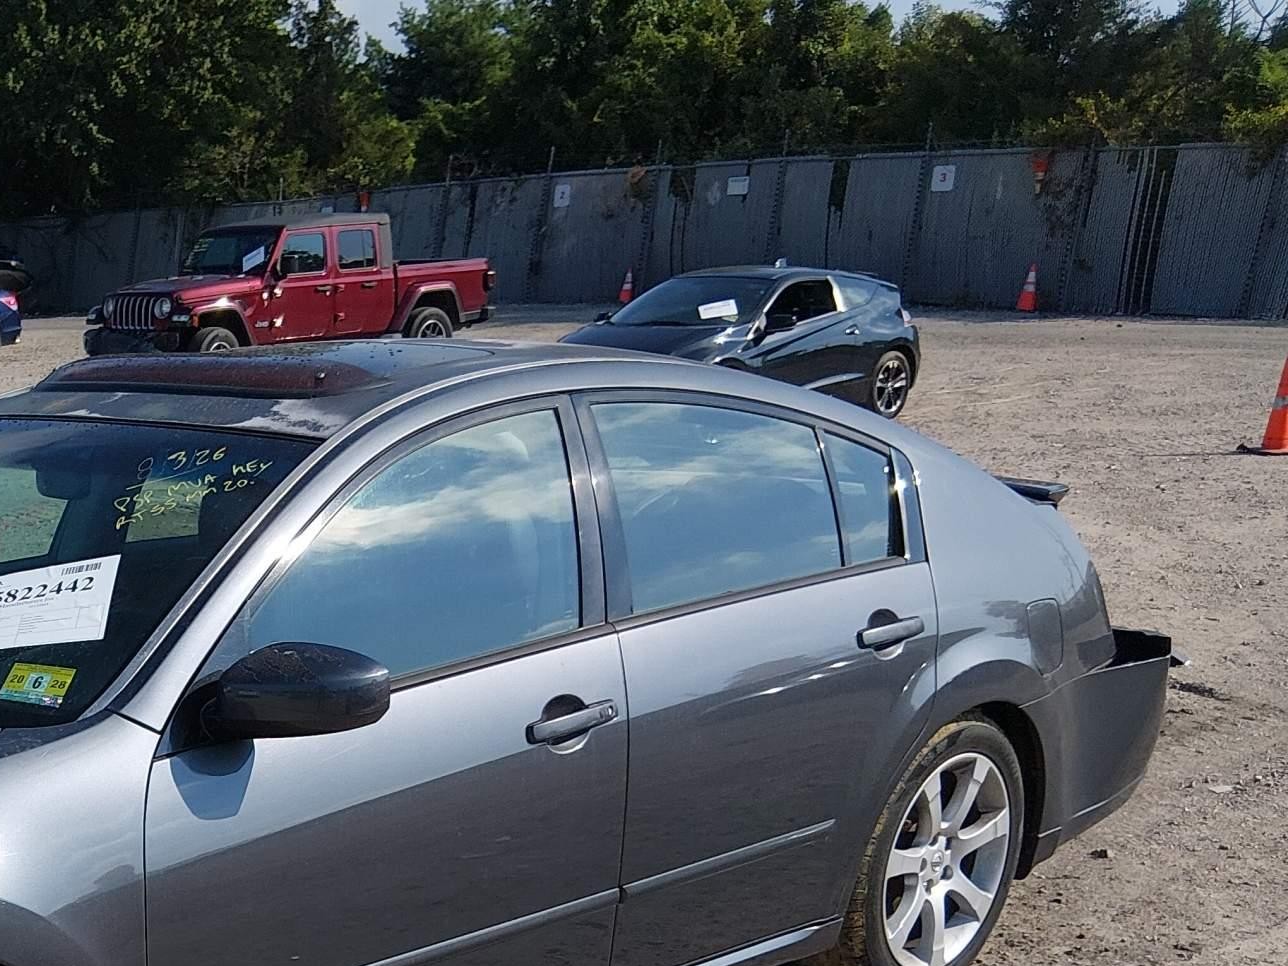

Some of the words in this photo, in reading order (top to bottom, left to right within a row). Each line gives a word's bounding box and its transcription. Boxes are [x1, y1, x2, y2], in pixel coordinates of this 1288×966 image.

[9, 674, 26, 684] 20
[32, 675, 44, 689] 6
[50, 679, 68, 690] 28
